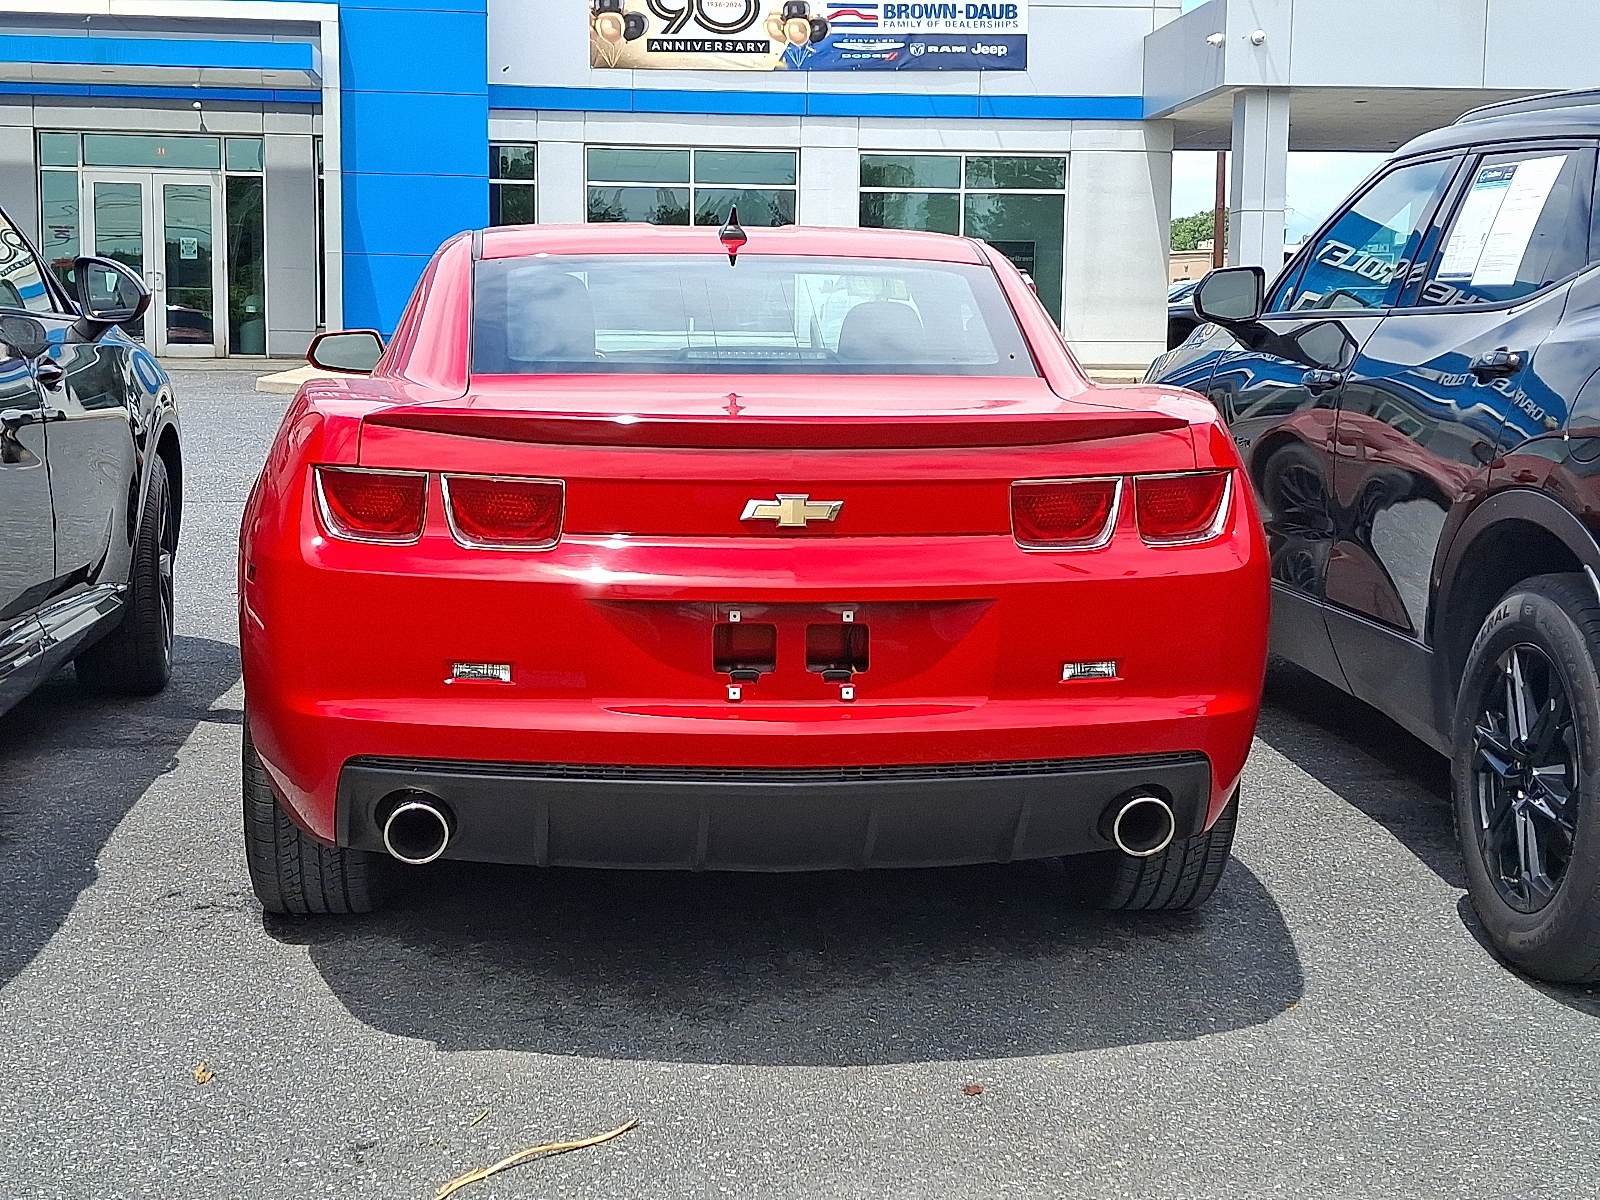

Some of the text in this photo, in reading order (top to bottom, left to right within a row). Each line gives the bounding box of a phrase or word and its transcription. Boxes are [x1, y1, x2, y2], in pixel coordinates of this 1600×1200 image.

[883, 3, 1018, 20] BROWN-DAUB
[883, 20, 1019, 29] FAMILY OF DEALERSHIPS
[651, 41, 766, 52] ANNIVERSARY
[927, 45, 967, 53] RAM
[971, 42, 1008, 57] Jeep
